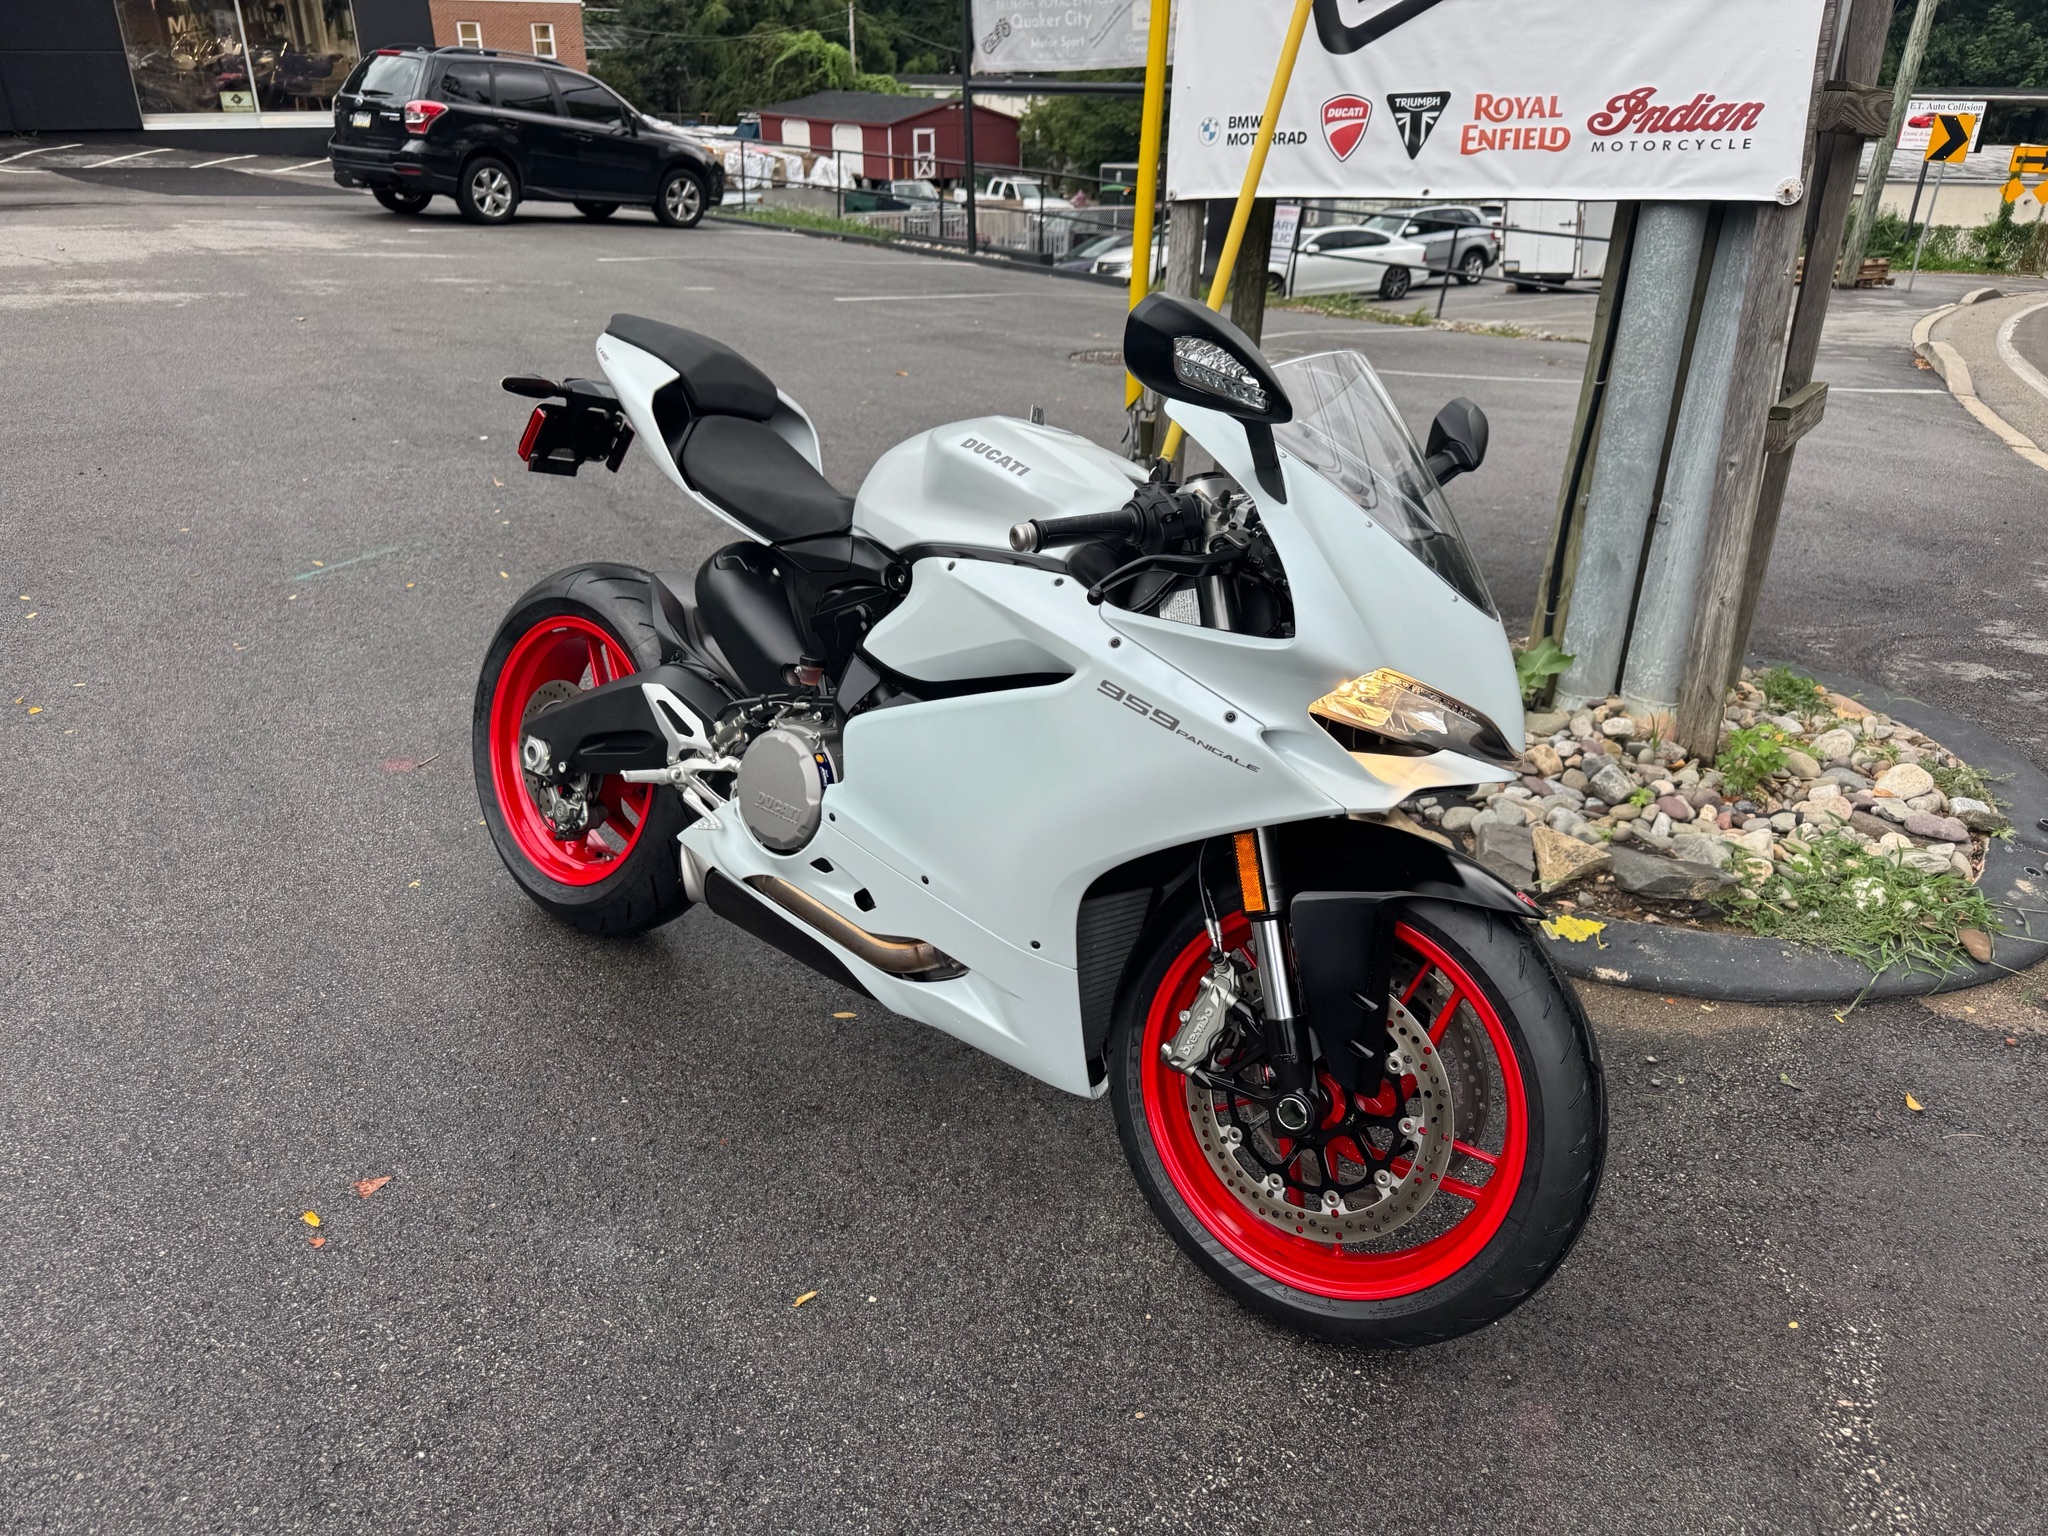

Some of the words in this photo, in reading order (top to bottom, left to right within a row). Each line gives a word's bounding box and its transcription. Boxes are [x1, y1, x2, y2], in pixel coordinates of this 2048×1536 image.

[1011, 10, 1060, 29] Quaker
[1064, 10, 1093, 29] City
[1327, 106, 1364, 119] DUCATI
[1394, 96, 1441, 108] TRIUMPH
[1474, 93, 1563, 123] ROYAL
[1587, 87, 1765, 136] Indian
[1909, 102, 1925, 110] E.T.
[1926, 102, 1946, 111] Auto
[1947, 102, 1984, 111] Collision
[1228, 115, 1264, 129] BMW
[1460, 124, 1571, 155] ENFIELD
[1591, 138, 1753, 153] MOTORCYCLE
[960, 438, 1031, 477] DUCATI
[1096, 679, 1181, 732] 959
[1175, 729, 1261, 773] PANIGALE
[754, 791, 802, 825] DUCATI
[1179, 1006, 1214, 1056] brembo
[1148, 1157, 1204, 1240] DIABLO
